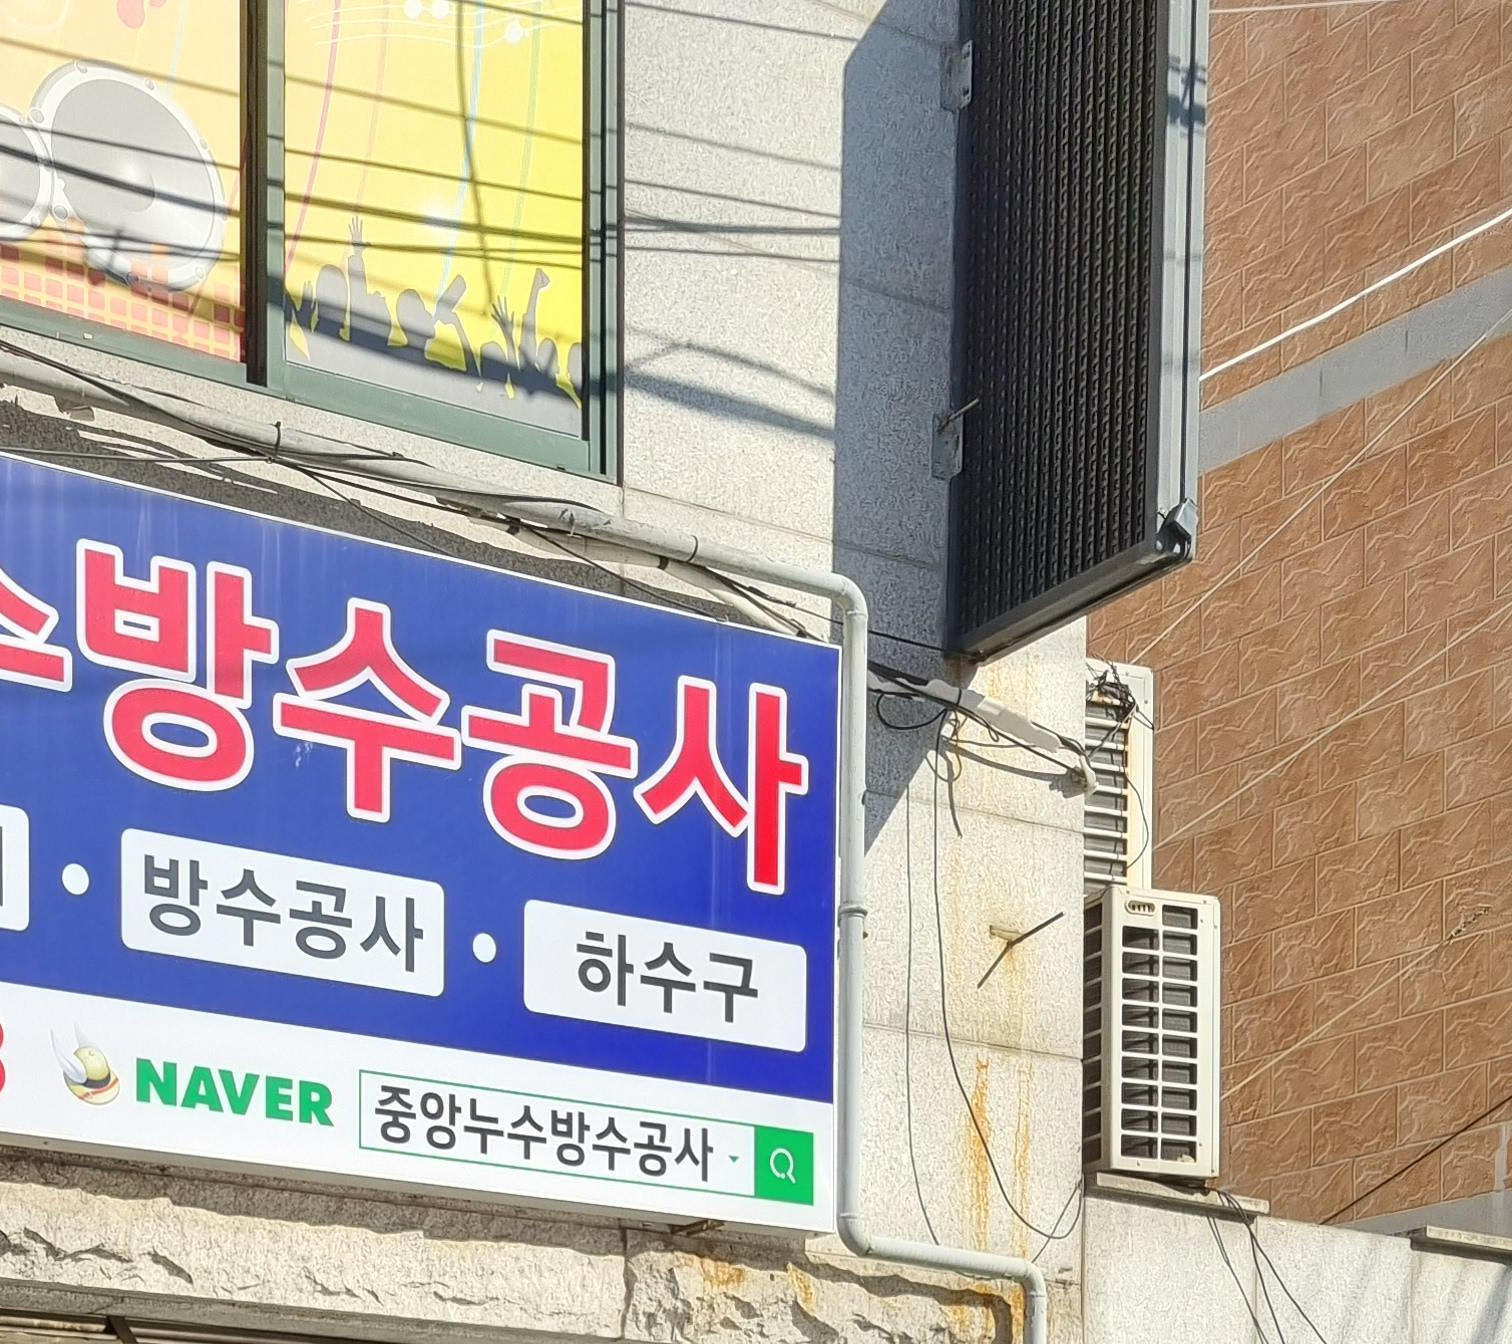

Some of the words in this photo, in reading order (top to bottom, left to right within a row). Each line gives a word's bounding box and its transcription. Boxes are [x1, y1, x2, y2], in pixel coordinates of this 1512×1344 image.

[143, 854, 425, 974] 방수공사
[575, 929, 760, 1024] 하수구
[134, 1057, 334, 1129] NAVER
[373, 1083, 714, 1183] 중앙누수방수공사
